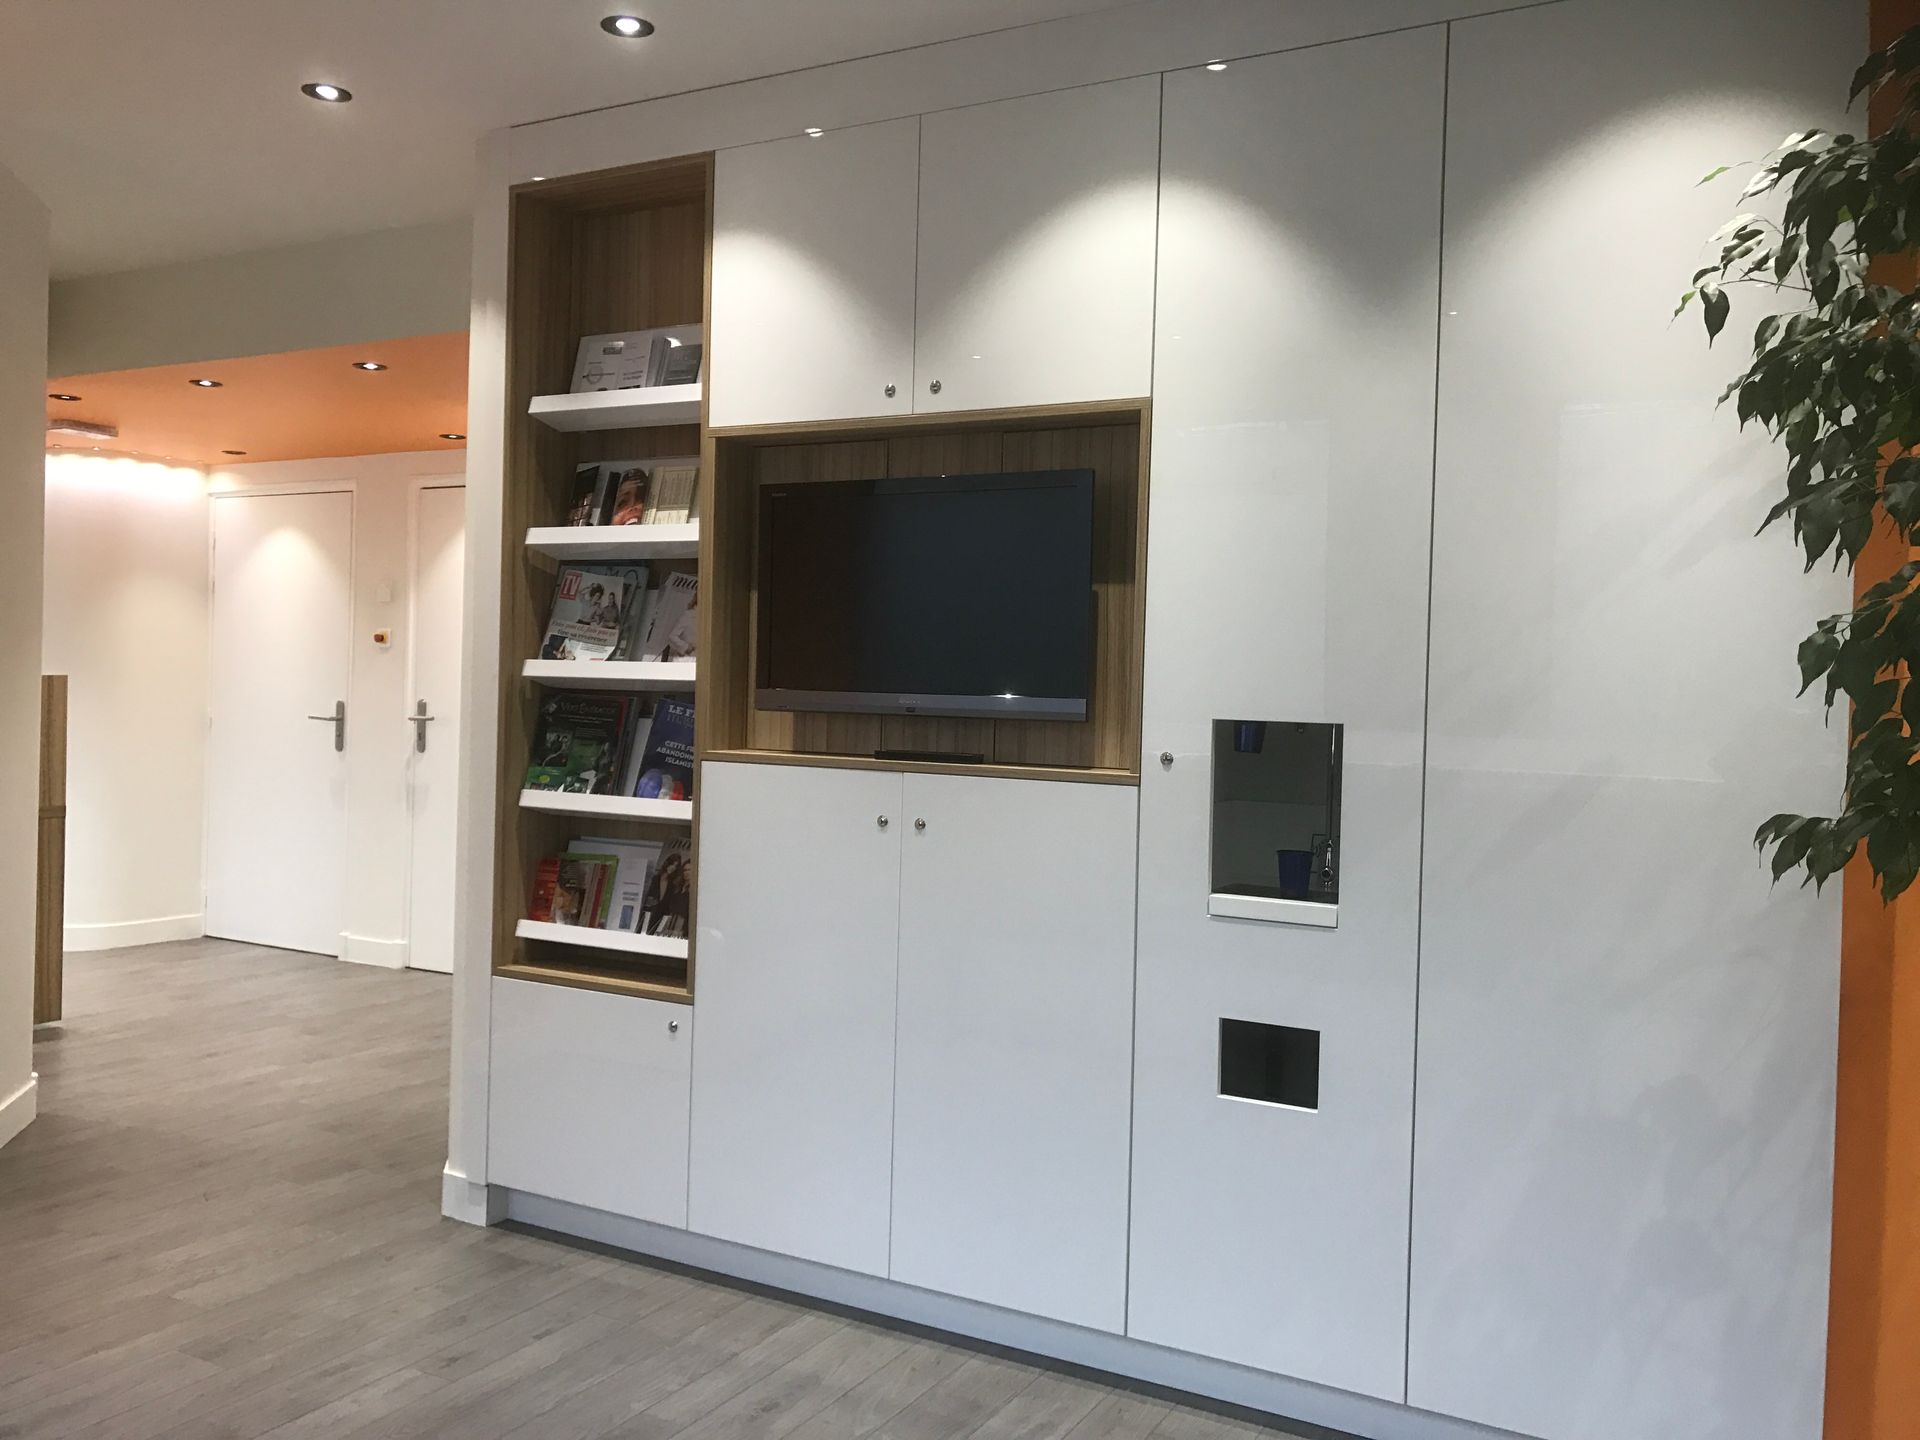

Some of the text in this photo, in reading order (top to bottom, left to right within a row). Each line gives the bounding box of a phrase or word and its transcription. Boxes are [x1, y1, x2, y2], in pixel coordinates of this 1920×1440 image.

[562, 574, 582, 596] TV
[668, 704, 695, 718] LE F
[664, 740, 686, 751] CETTE
